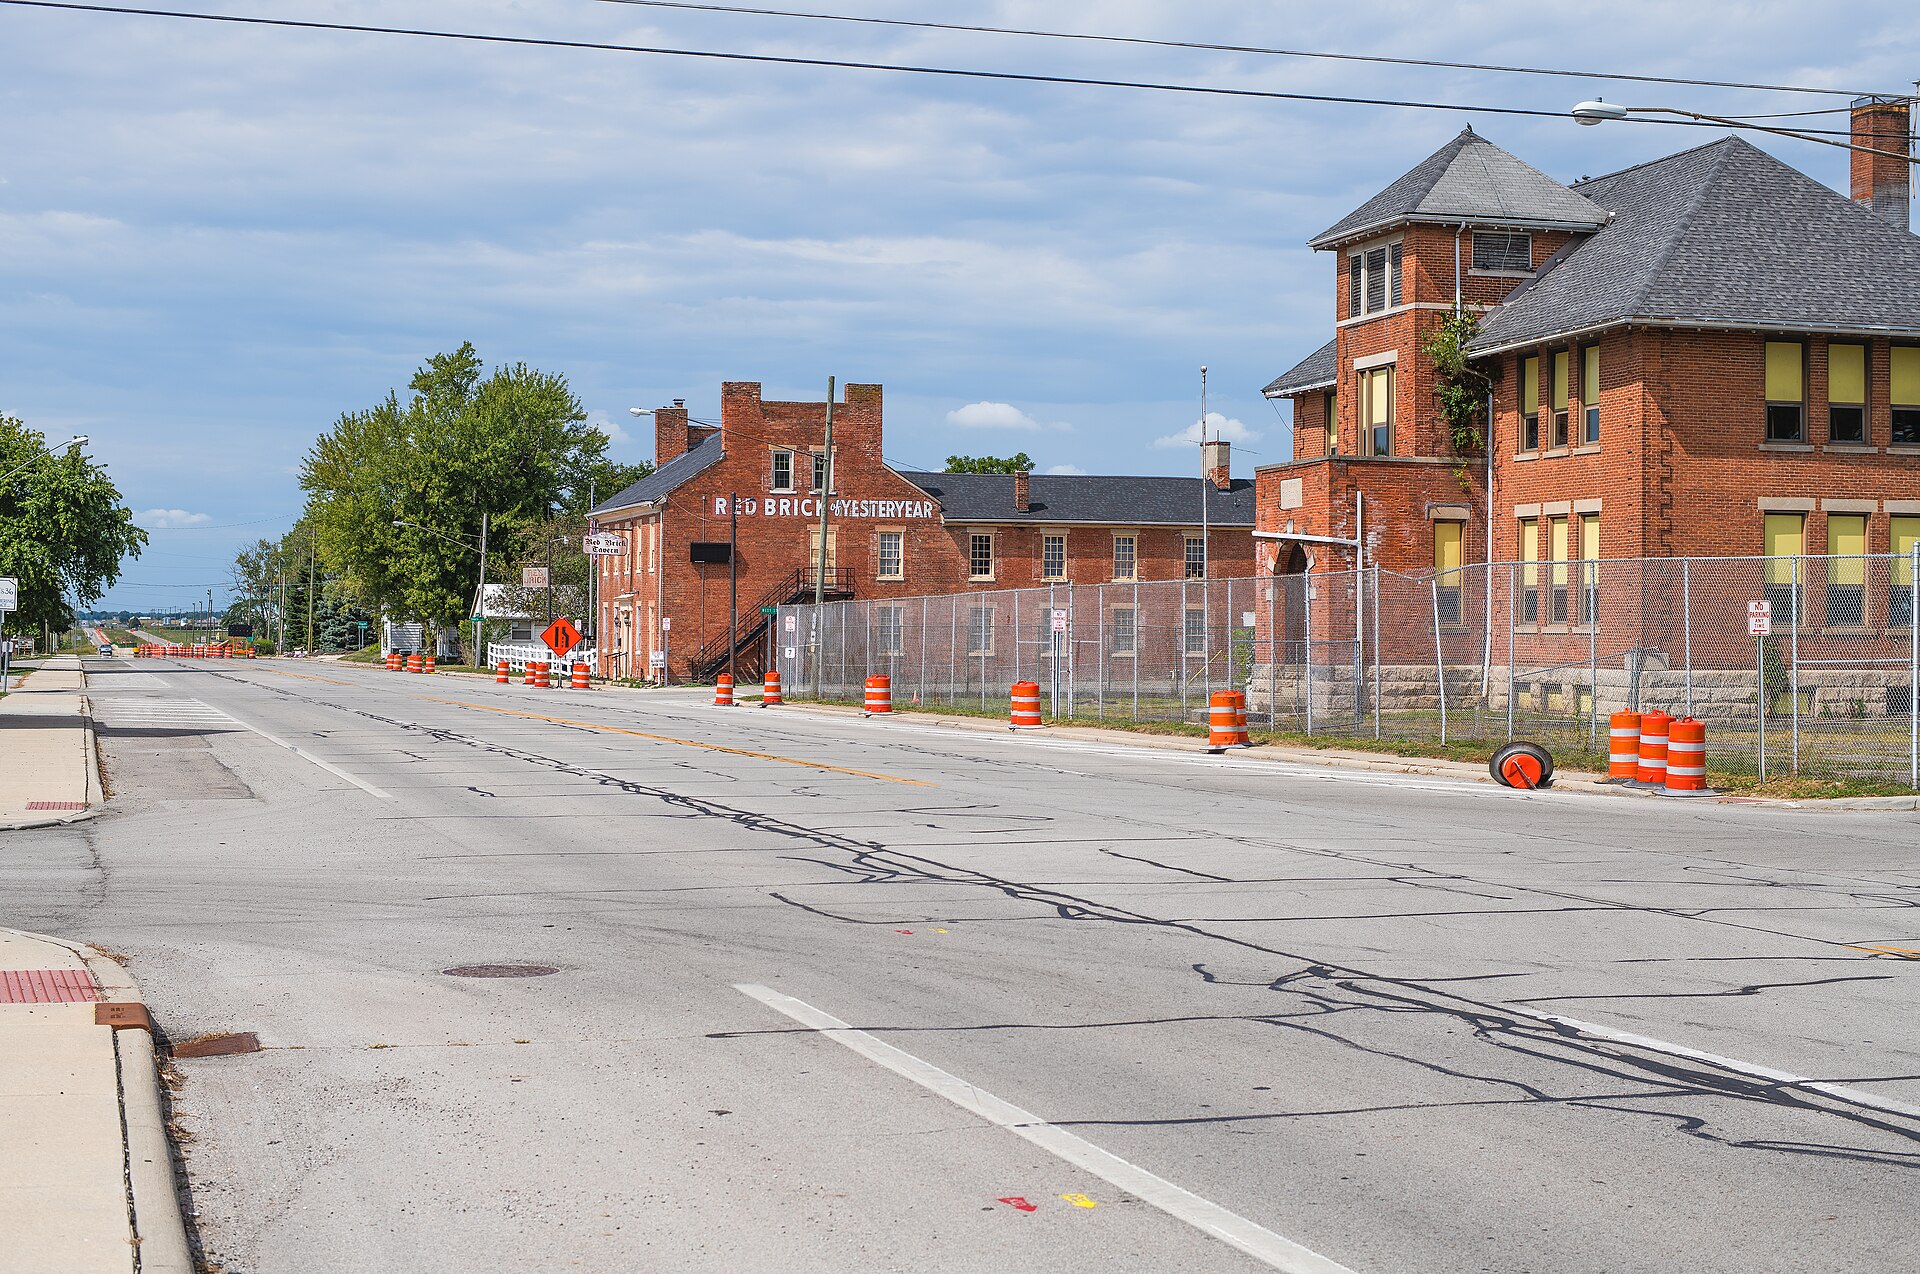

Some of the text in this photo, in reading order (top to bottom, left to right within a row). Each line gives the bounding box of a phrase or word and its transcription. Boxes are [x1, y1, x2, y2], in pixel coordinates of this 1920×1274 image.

[715, 497, 757, 517] RED
[830, 499, 841, 517] of
[840, 499, 933, 519] YESTERYEAR
[585, 538, 626, 547] Red Brick
[592, 546, 619, 554] Tavern
[1755, 603, 1764, 611] NO
[1750, 611, 1770, 619] PARKING
